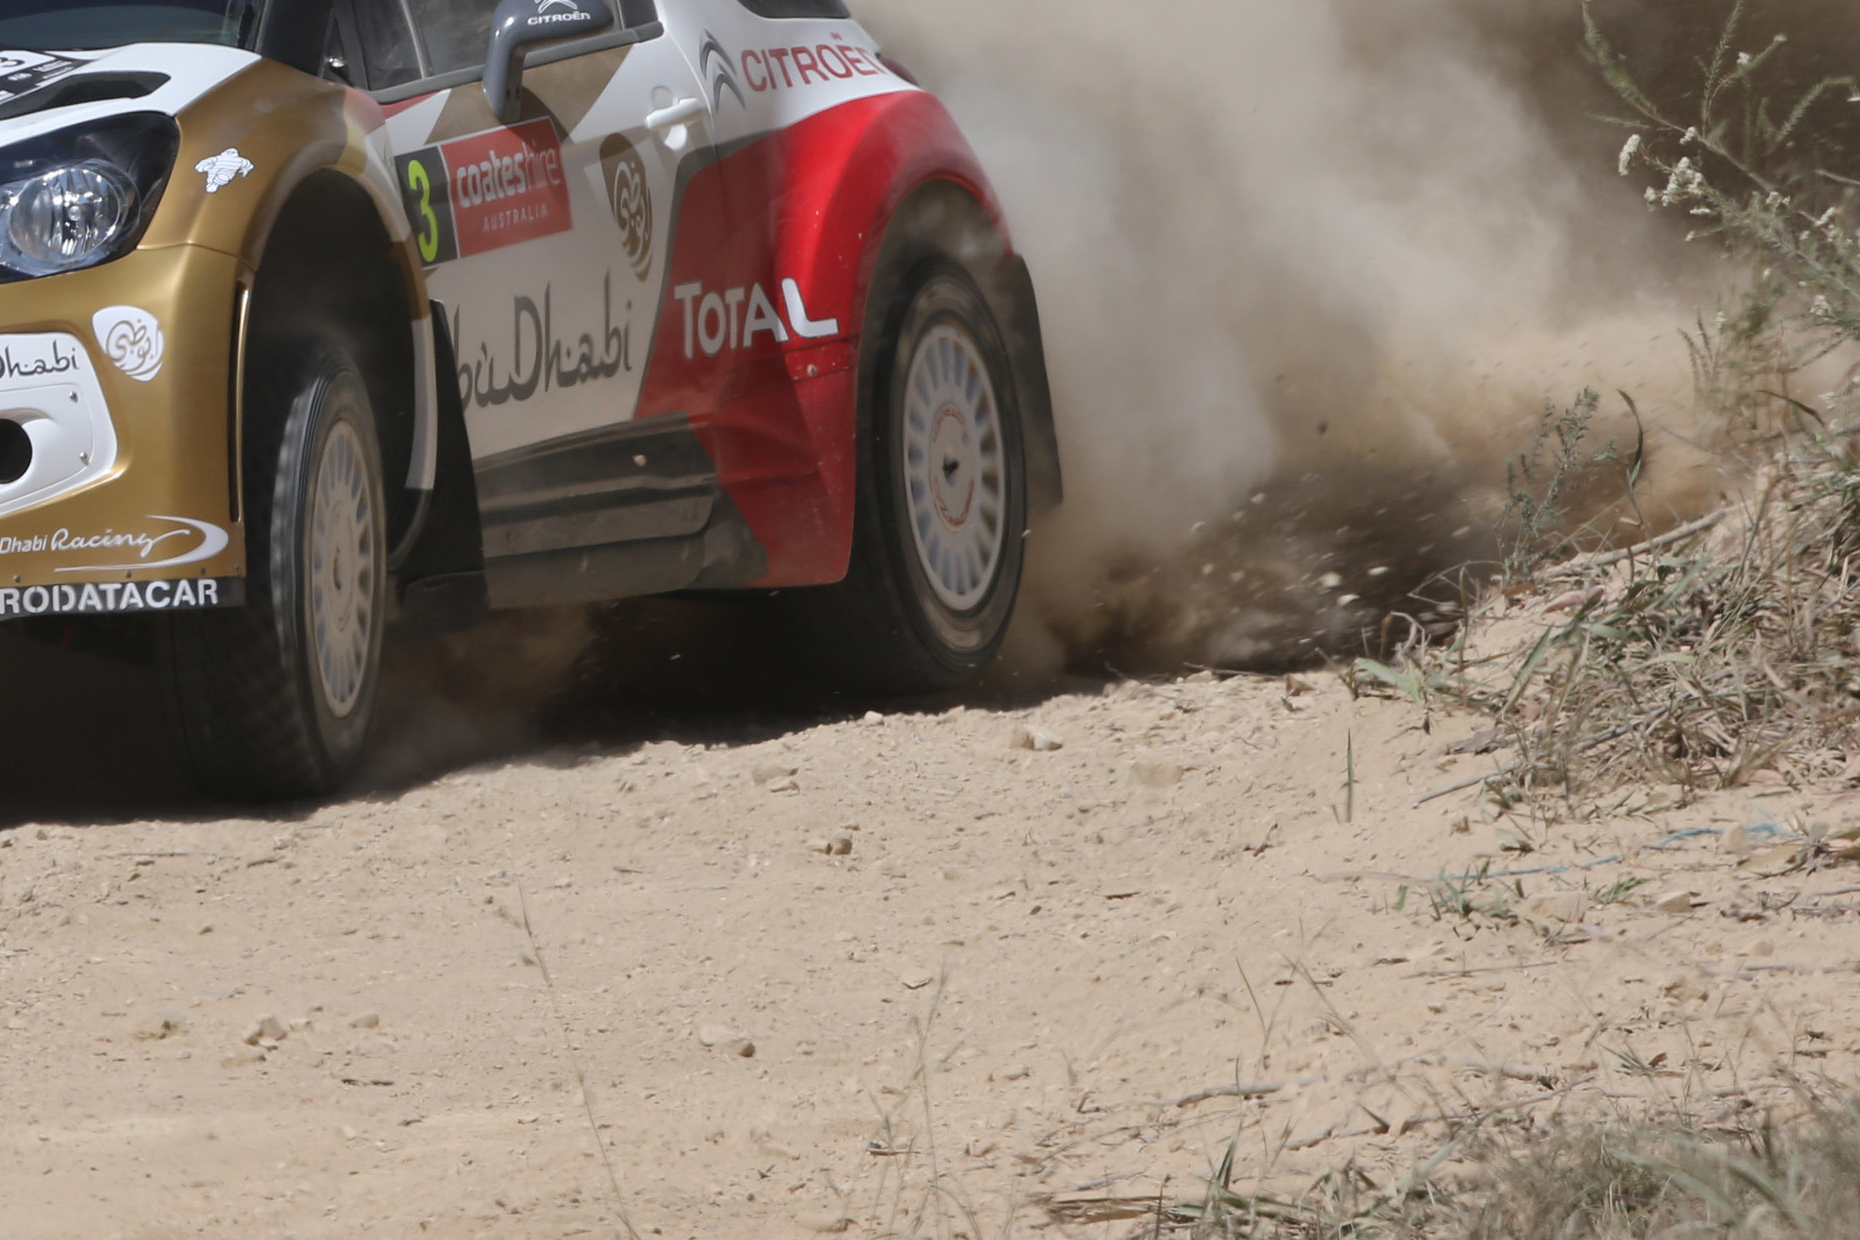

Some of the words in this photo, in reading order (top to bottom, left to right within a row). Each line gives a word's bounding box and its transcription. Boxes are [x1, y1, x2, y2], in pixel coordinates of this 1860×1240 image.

[408, 159, 438, 262] 3
[483, 203, 548, 233] AUSTRALIA
[674, 278, 839, 359] TOTAL
[49, 528, 191, 559] Racing
